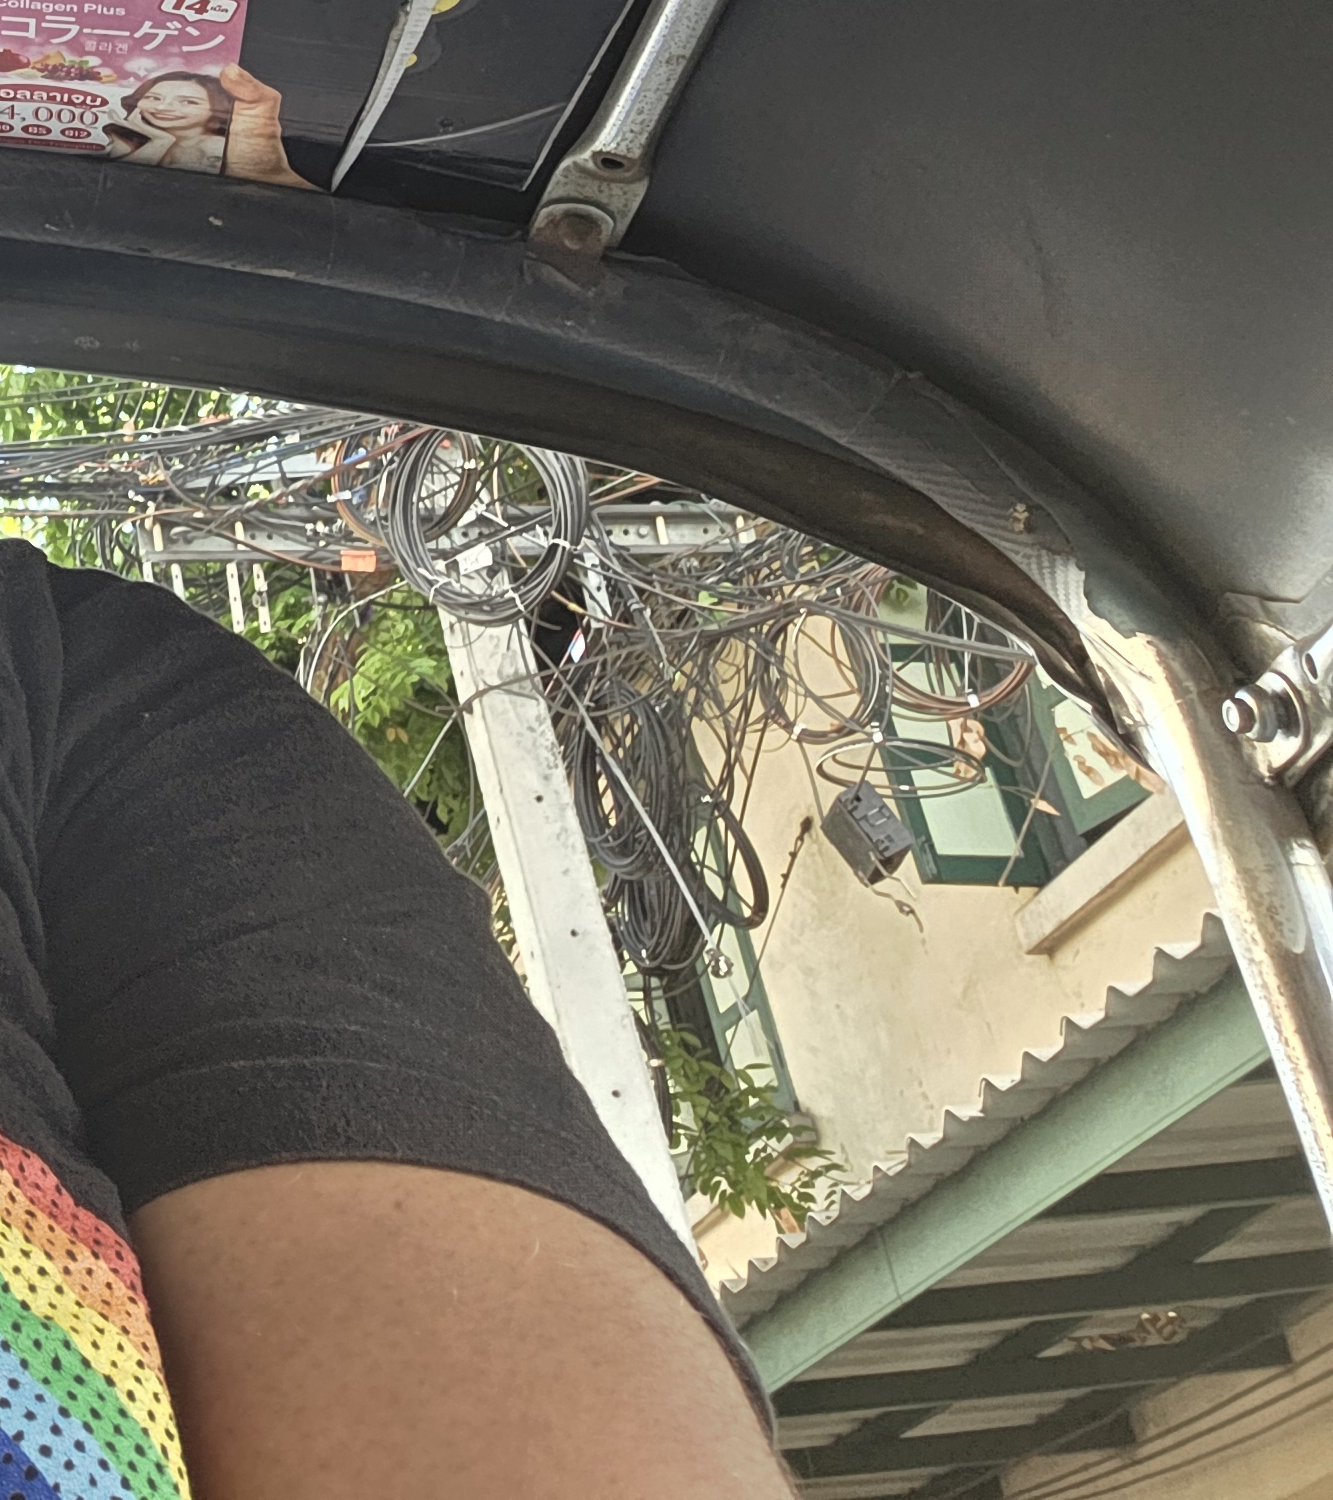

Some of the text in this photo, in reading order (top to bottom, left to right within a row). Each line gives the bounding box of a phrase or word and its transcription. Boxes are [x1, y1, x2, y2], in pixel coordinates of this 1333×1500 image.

[83, 2, 127, 17] Plus
[0, 14, 226, 52] コラーゲン
